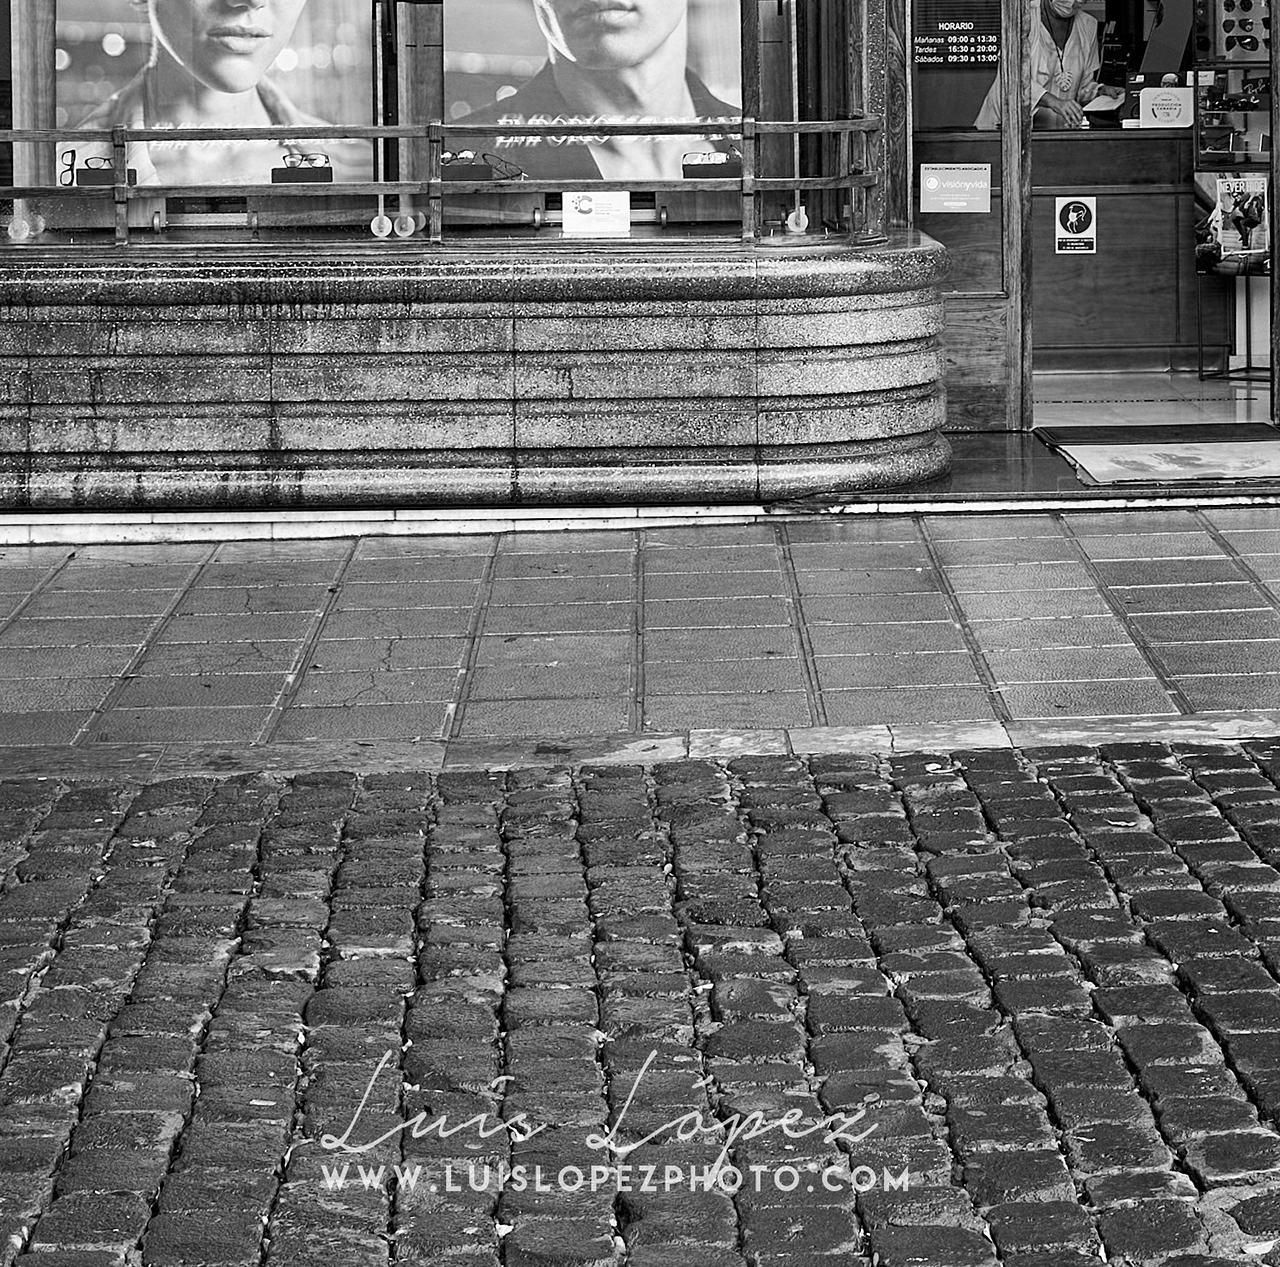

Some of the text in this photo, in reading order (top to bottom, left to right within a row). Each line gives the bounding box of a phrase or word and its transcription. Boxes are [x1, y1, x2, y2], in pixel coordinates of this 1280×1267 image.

[938, 22, 974, 30] HORARIO
[914, 36, 945, 44] Mañanas
[947, 35, 969, 43] 09:00
[977, 35, 997, 43] 13:30
[914, 45, 937, 53] Tardes
[948, 45, 969, 53] 16:30
[914, 55, 944, 63] Sábados
[977, 54, 998, 62] 13:00
[1220, 181, 1265, 192] NEVER HIDE
